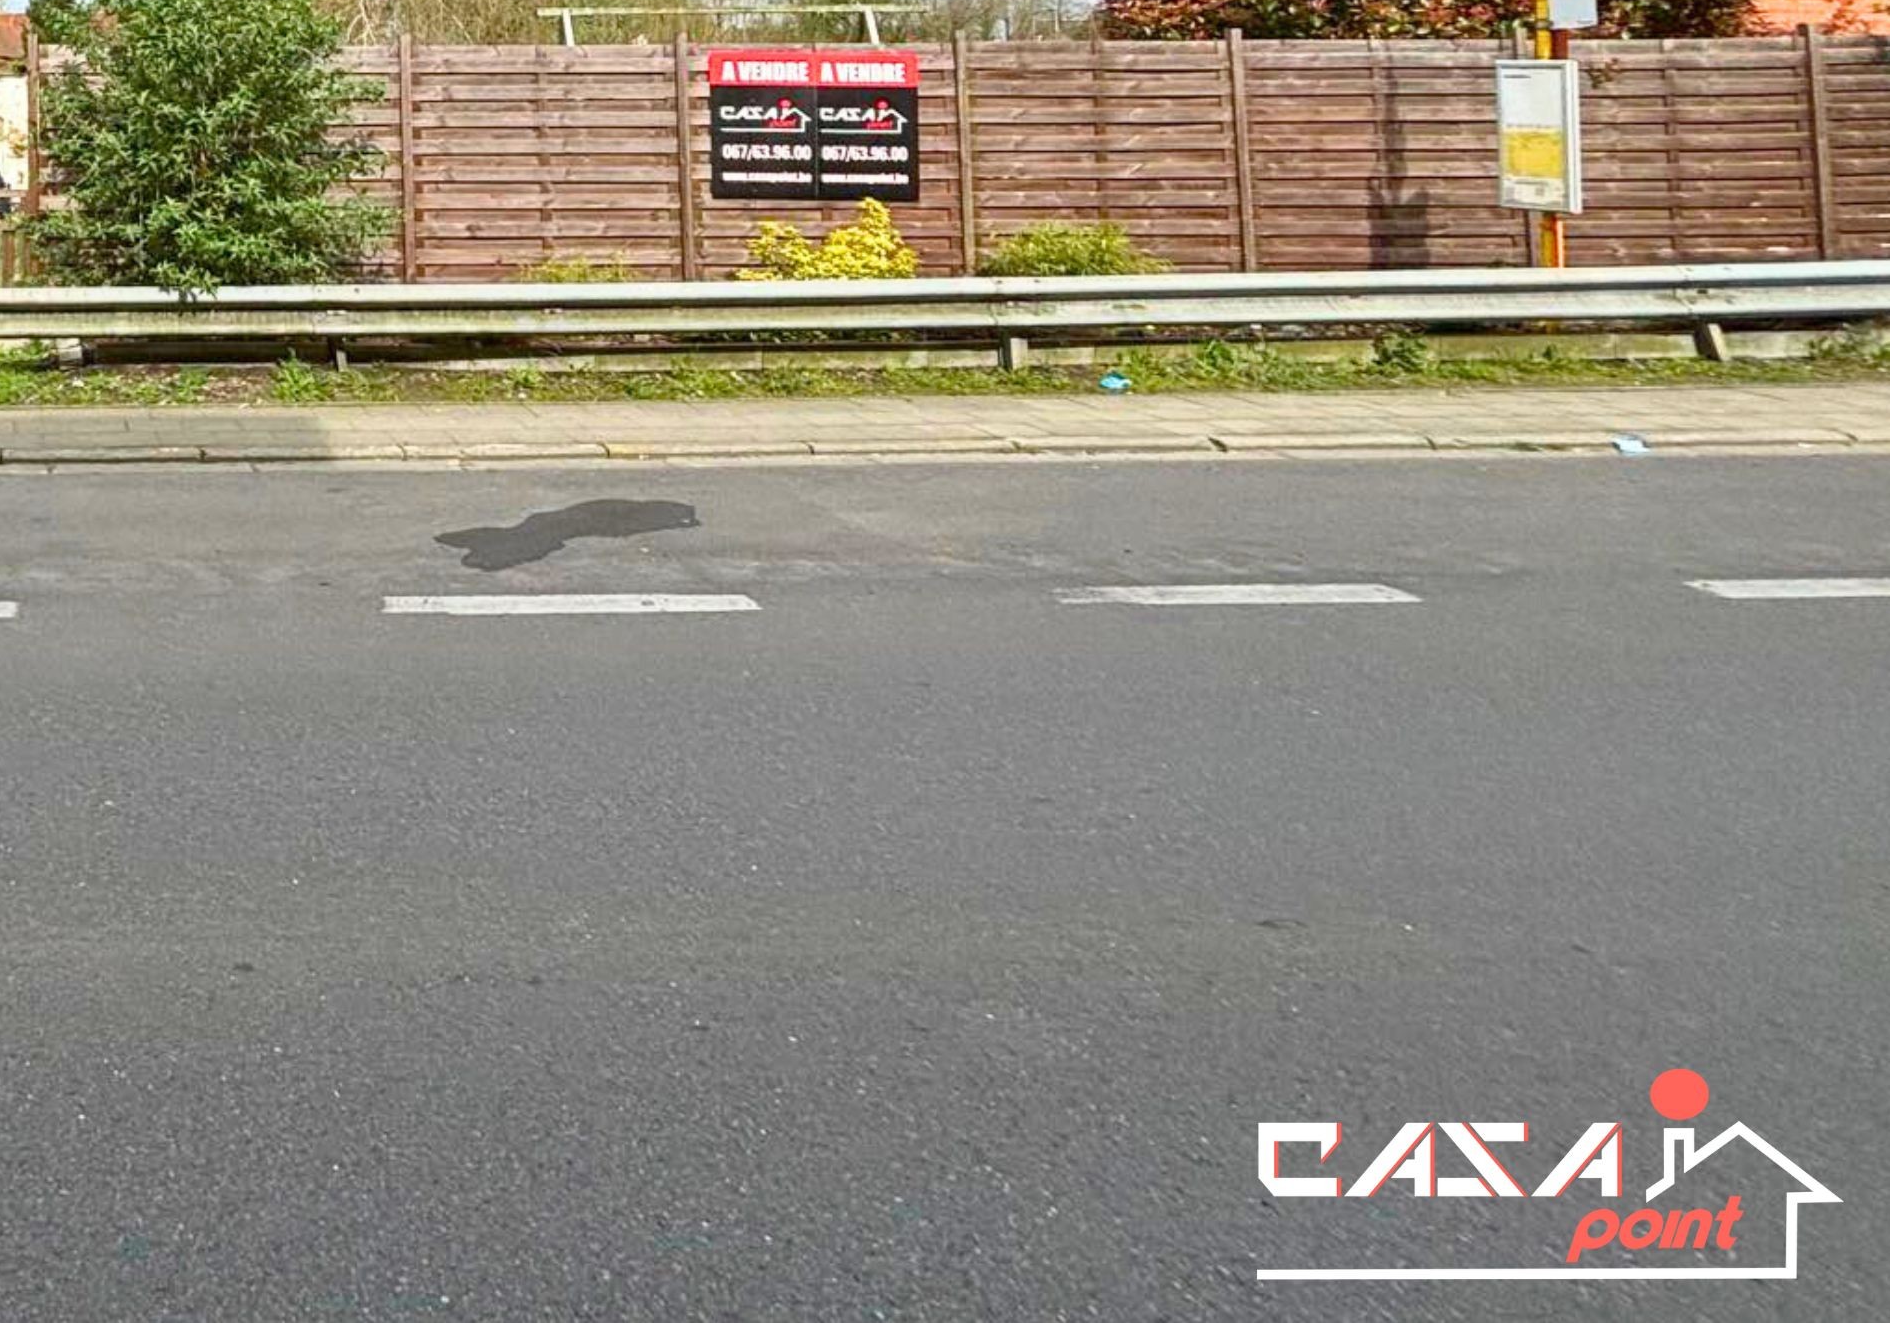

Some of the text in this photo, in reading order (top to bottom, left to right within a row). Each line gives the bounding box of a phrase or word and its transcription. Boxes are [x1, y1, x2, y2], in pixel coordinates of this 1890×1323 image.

[722, 61, 809, 81] A VENDRE
[821, 62, 906, 83] A VENDRE
[719, 106, 778, 120] CASA
[819, 108, 876, 121] CASA
[721, 144, 812, 161] 067/63.96.00
[821, 146, 909, 162] 067/63.96.00
